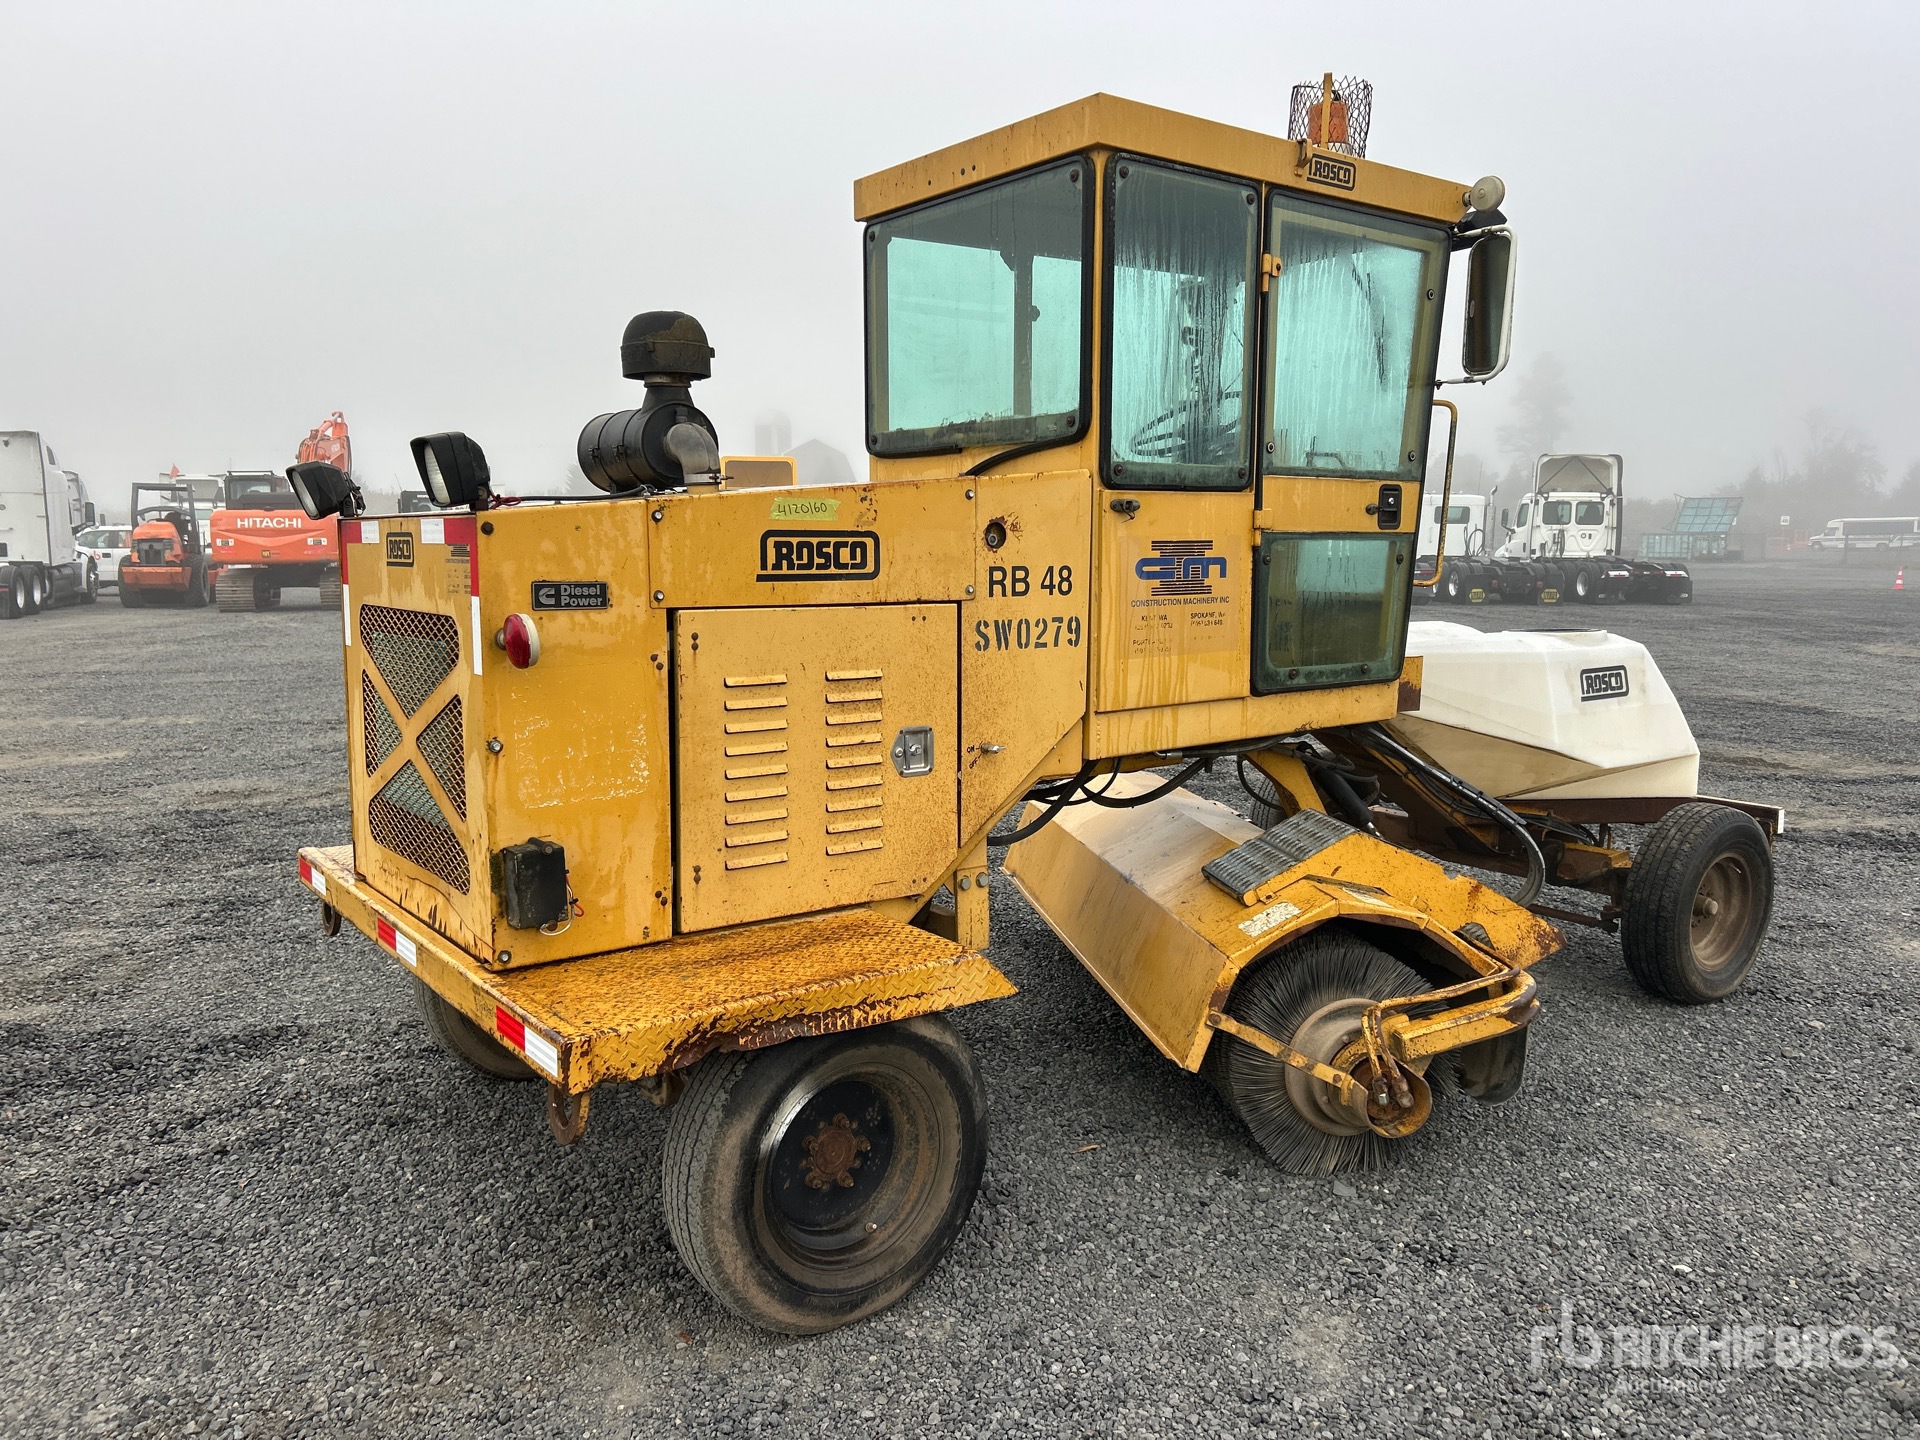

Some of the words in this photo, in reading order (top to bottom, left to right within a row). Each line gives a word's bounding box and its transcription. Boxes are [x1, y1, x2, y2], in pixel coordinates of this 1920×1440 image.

[1313, 159, 1351, 184] ROSCO
[778, 502, 827, 516] 4120160
[237, 518, 301, 528] HITACHI
[389, 539, 411, 559] ROSCO
[771, 540, 868, 571] ROSCO
[560, 584, 600, 595] Diesel
[988, 566, 1031, 597] RB
[1040, 565, 1073, 595] 48
[560, 596, 603, 606] Power
[1131, 599, 1182, 608] CONSTRUCTION
[1183, 597, 1219, 605] MACHINERY
[1220, 596, 1230, 604] INC
[974, 616, 1081, 652] SW0279
[1585, 671, 1624, 694] ROSCO
